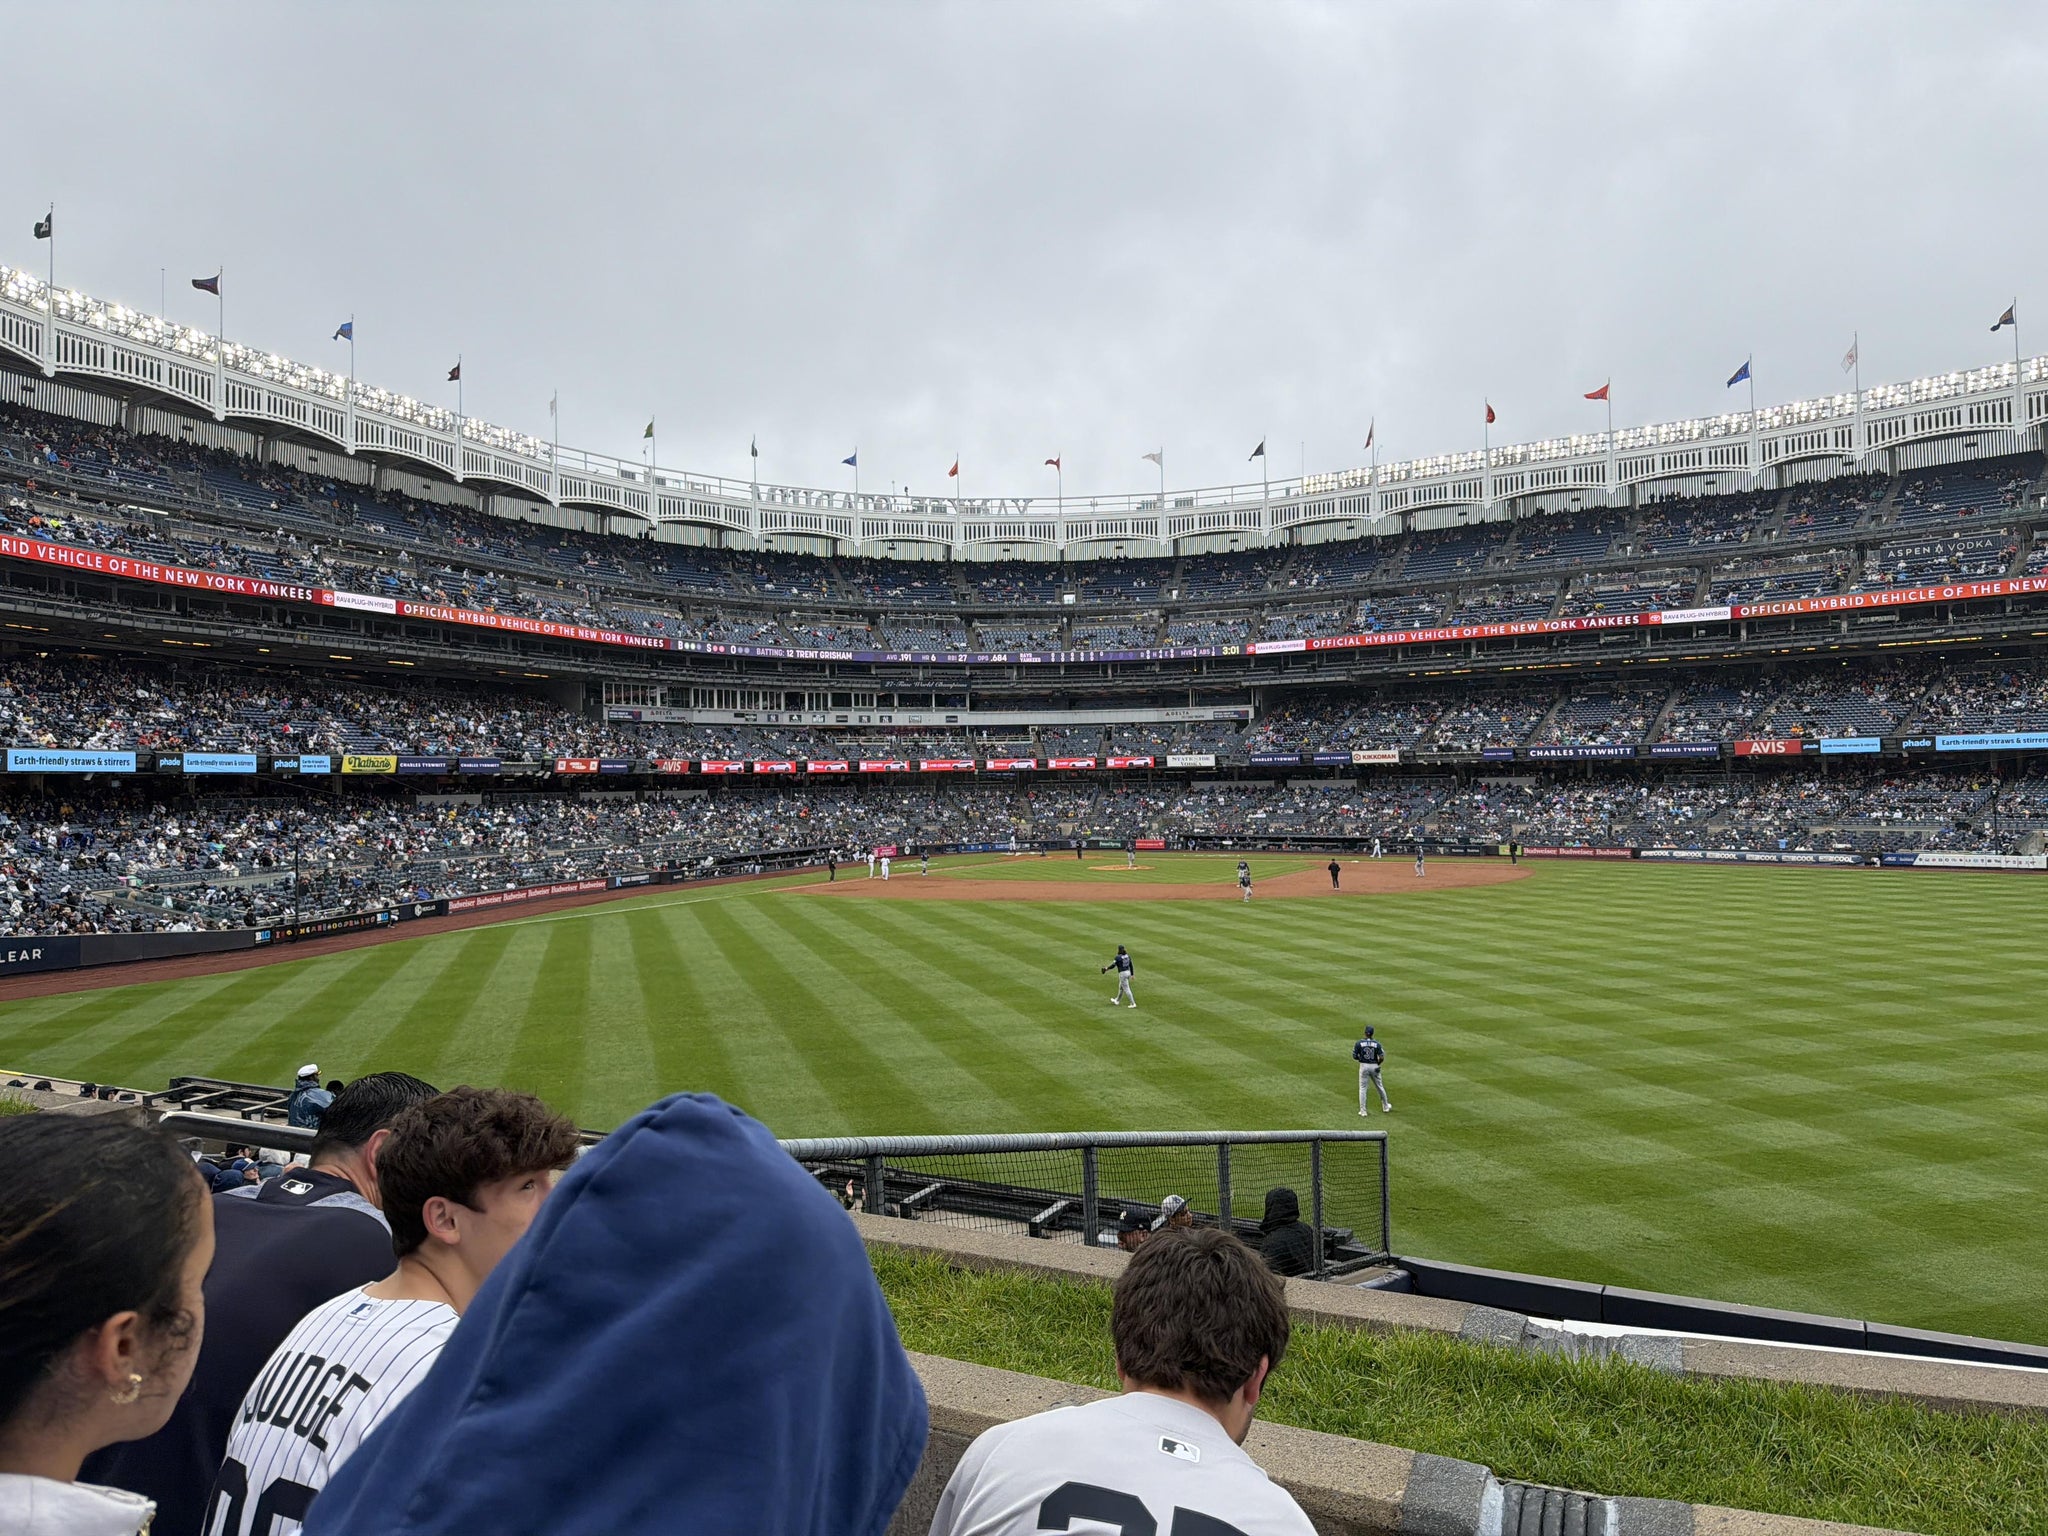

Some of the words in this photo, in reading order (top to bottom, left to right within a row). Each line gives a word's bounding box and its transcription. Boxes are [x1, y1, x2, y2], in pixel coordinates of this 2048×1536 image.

[1887, 546, 1931, 558] ASPEN
[1947, 539, 1993, 551] VODKA
[37, 545, 103, 568] VEHICLE
[109, 559, 128, 573] OF
[134, 563, 159, 579] THE
[165, 570, 199, 585] NEW
[206, 575, 245, 592] YORK
[251, 582, 313, 600] YANKEES
[1740, 602, 1803, 615] OFFICIAL
[1810, 597, 1864, 609] HYBRID
[1871, 589, 1936, 604] VEHICLE
[1943, 586, 1964, 598] OF
[1971, 582, 2001, 596] THE
[2009, 578, 2047, 591] NEW
[403, 603, 454, 620] OFFICIAL
[458, 611, 497, 626] HYBRID
[500, 618, 540, 632] VEHICLE
[543, 624, 557, 633] OF
[558, 625, 575, 636] THE
[578, 628, 597, 640] NEW
[600, 631, 622, 643] YORK
[624, 635, 664, 648] YANKEES
[1313, 637, 1360, 648] OFFICIAL
[1366, 633, 1405, 644] HYBRID
[1410, 629, 1457, 641] VEHICLE
[1463, 628, 1479, 637] OF
[1483, 626, 1505, 635] THE
[1511, 623, 1538, 633] NEW
[1543, 620, 1577, 631] YORK
[1581, 615, 1640, 628] YANKEES
[678, 641, 684, 649] B
[707, 644, 712, 653] S
[1222, 646, 1239, 655] 3:01
[756, 647, 785, 657] BATTING:
[786, 649, 794, 658] 12
[796, 650, 819, 659] TRENT
[820, 651, 852, 660] GRISHAM
[898, 653, 911, 661] .191
[958, 654, 967, 662] 27
[991, 654, 1007, 662] .684
[1750, 741, 1785, 754] AVIS
[1902, 739, 1932, 749] phade
[1530, 749, 1574, 757] CHARLES
[1578, 748, 1632, 756] TYRWHITT
[14, 755, 69, 766] Earth-friendly
[71, 757, 96, 766] straws
[97, 757, 102, 766] &
[104, 757, 130, 767] stirrers
[160, 757, 181, 768] phade
[187, 758, 217, 768] Earth-friendly
[274, 759, 298, 771] phade
[348, 756, 391, 768] Nathan's
[662, 761, 682, 772] AVIS
[551, 884, 578, 894] Budweiser
[579, 880, 606, 891] Budweiser
[503, 891, 526, 902] Budweiser
[528, 888, 550, 897] Budweiser
[448, 898, 476, 910] Budweiser
[476, 895, 502, 906] Budweiser
[243, 1351, 372, 1452] JUDGE
